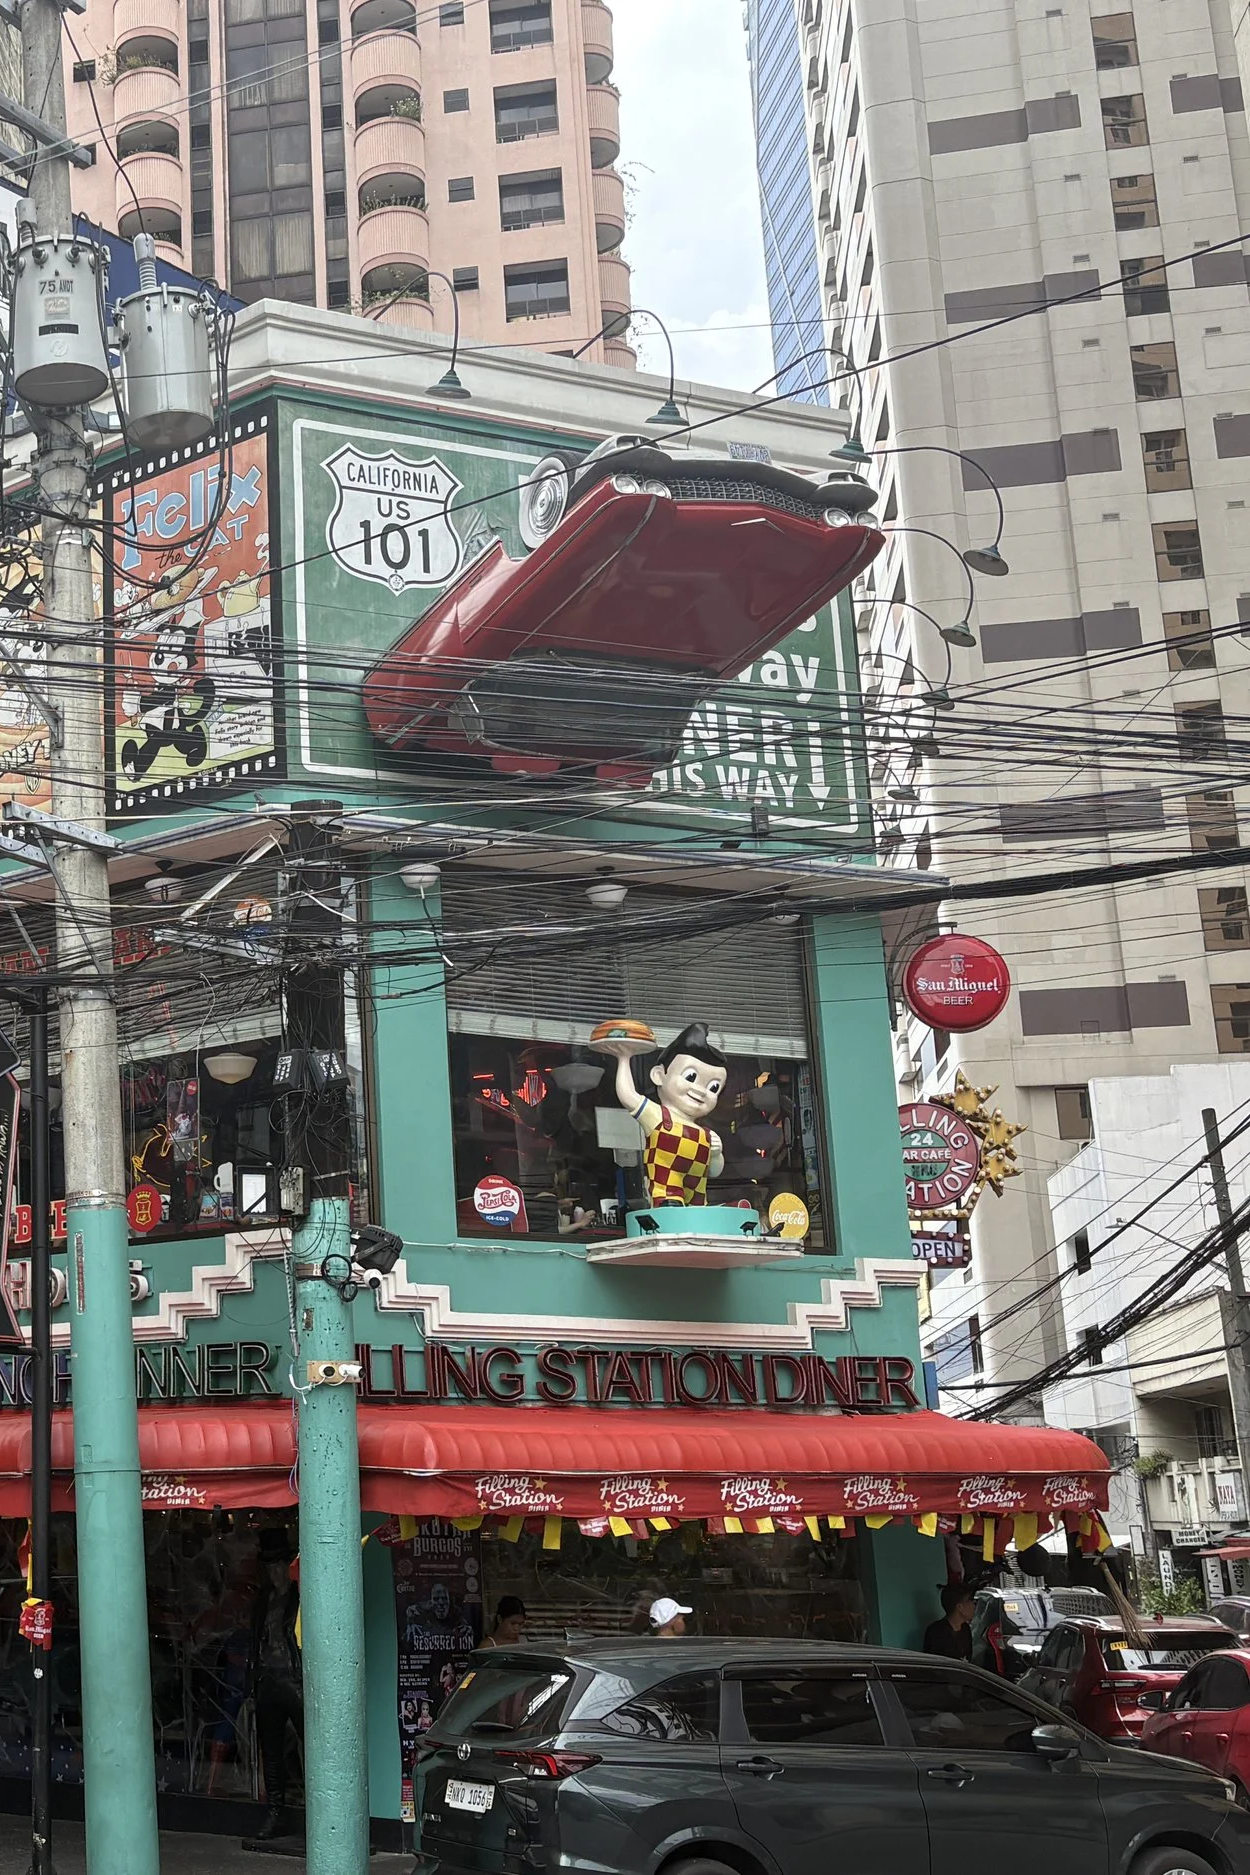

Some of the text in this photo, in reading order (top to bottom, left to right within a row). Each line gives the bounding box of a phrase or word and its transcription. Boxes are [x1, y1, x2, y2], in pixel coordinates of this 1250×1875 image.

[39, 280, 56, 295] 75
[347, 462, 440, 495] CALIFORNIA
[121, 464, 263, 571] Felix
[377, 497, 411, 520] US
[184, 514, 249, 558] CAT
[360, 519, 431, 574] 101
[155, 548, 183, 569] the
[716, 765, 799, 808] WAY
[916, 976, 1000, 993] San Miguel
[943, 995, 974, 1006] BEER
[900, 1108, 970, 1150] LLING
[910, 1133, 934, 1146] 24
[902, 1150, 918, 1160] AR
[905, 1158, 973, 1202] ATION
[912, 1240, 956, 1258] OPEN
[133, 1341, 272, 1401] NNER
[356, 1344, 921, 1408] ILLING STATION DINER
[141, 1484, 207, 1500] tation
[474, 1474, 534, 1499] Filling
[600, 1476, 655, 1501] Filling
[720, 1475, 773, 1501] Filling
[843, 1474, 894, 1500] Filling
[956, 1475, 1005, 1500] Filling
[1042, 1475, 1078, 1500] Filling
[1051, 1487, 1097, 1507] Station
[488, 1489, 565, 1510] Station
[613, 1489, 686, 1512] Station
[732, 1489, 803, 1512] Station
[854, 1490, 921, 1511] Station
[966, 1489, 1028, 1508] Station
[414, 1537, 462, 1557] BURGOS
[1161, 1552, 1174, 1595] LAUND
[414, 1635, 475, 1651] RESURRECION
[468, 1789, 487, 1806] 1056
